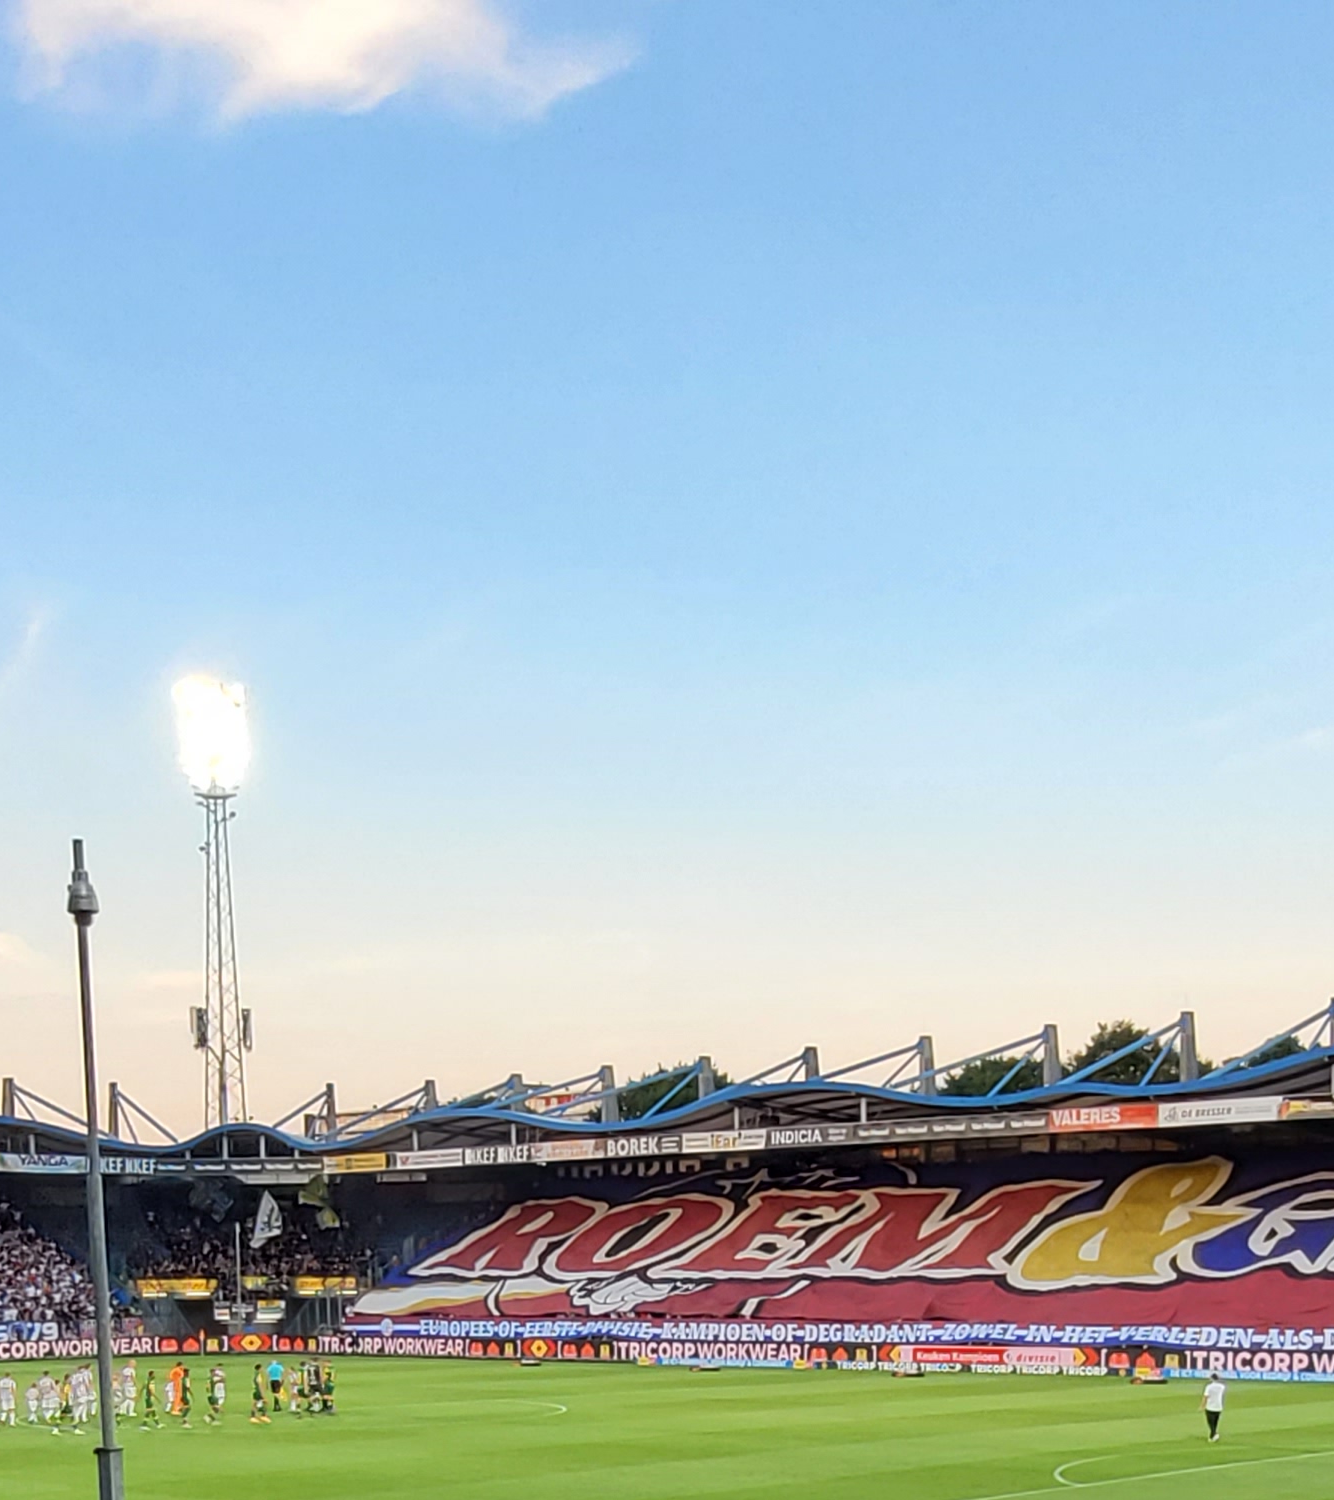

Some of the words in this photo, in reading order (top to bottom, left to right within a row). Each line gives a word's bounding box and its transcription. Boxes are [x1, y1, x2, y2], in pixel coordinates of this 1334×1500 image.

[1052, 1106, 1121, 1126] VALERES
[607, 1136, 659, 1155] BOREK
[771, 1129, 823, 1145] INDICIA
[17, 1154, 69, 1167] YANGA
[405, 1178, 1102, 1281] ROEM
[1007, 1155, 1262, 1292] &
[662, 1320, 766, 1342] KAMPIOEN
[771, 1321, 797, 1342] OF
[942, 1322, 1017, 1343] ZOWEL
[1023, 1324, 1051, 1343] IN
[1064, 1325, 1114, 1344] HET
[1119, 1326, 1253, 1348] VERLEDEN
[1264, 1328, 1316, 1350] ALS
[619, 1341, 695, 1361] TRICORP
[696, 1343, 801, 1362] WORKWEAR
[1194, 1351, 1309, 1374] TRICORP
